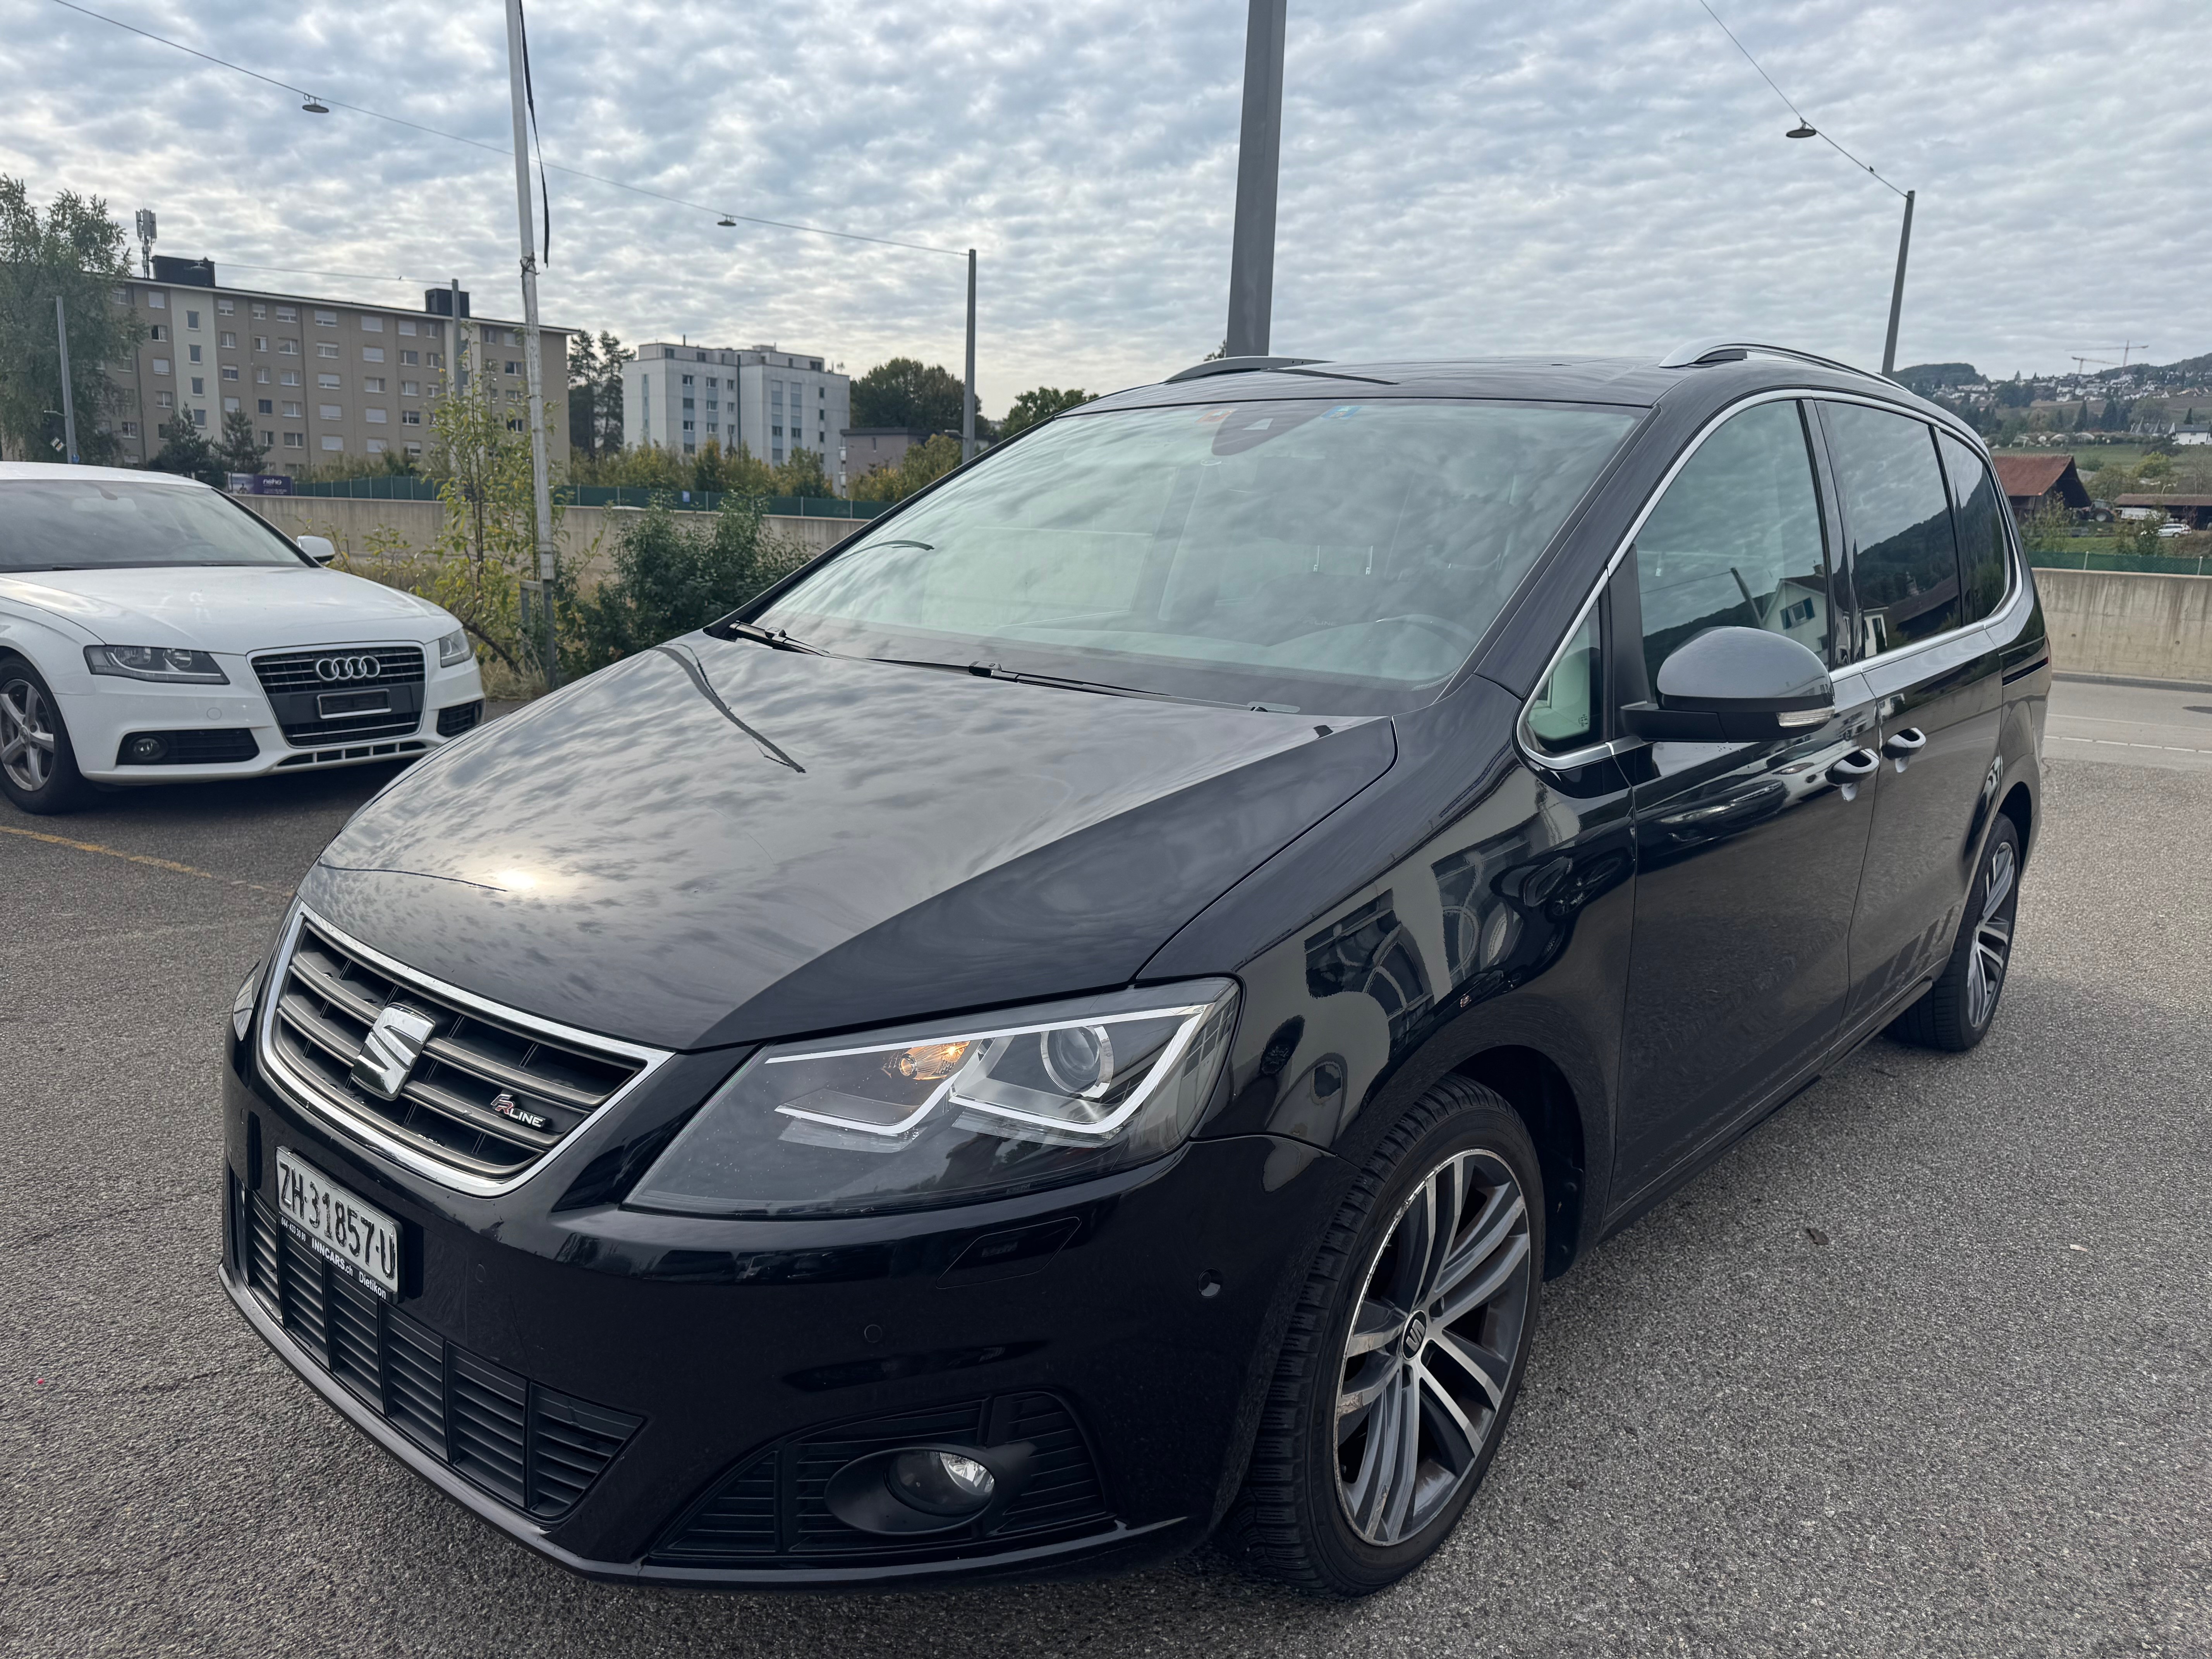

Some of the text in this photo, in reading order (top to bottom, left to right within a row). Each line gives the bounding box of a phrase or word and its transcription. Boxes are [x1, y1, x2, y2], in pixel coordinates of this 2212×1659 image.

[509, 1108, 543, 1128] LINE
[311, 1237, 386, 1300] INNCARS.ch Dietikon
